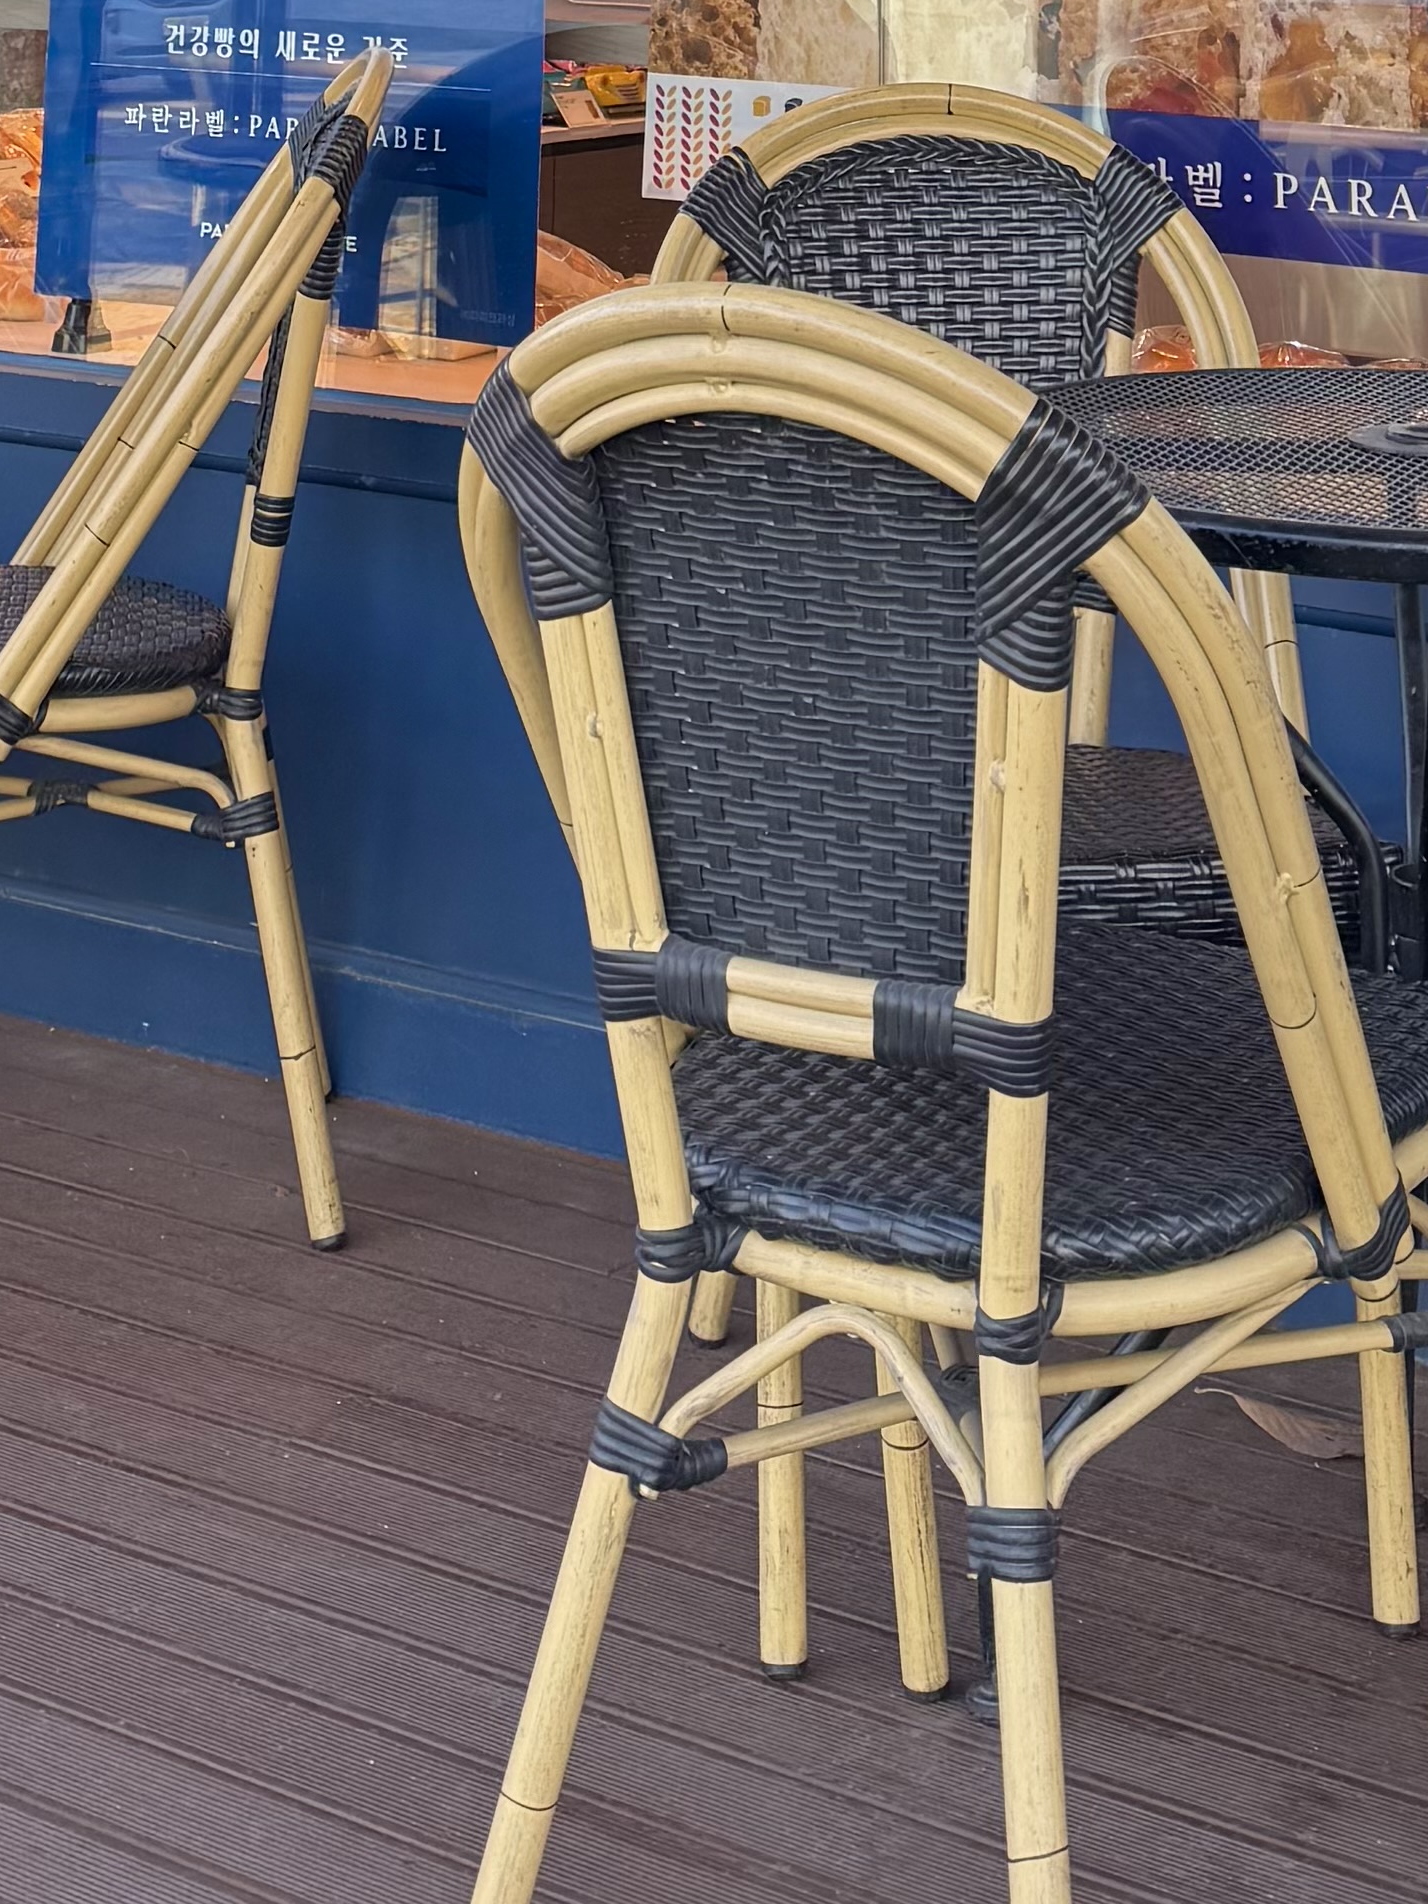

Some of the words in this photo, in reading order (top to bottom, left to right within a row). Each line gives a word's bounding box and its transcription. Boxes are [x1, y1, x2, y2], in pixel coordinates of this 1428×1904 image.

[164, 24, 260, 61] 건강빵의
[275, 30, 346, 65] 새로운
[123, 103, 226, 138] 파란라벨
[249, 115, 300, 140] PAR
[372, 125, 447, 153] ABEL
